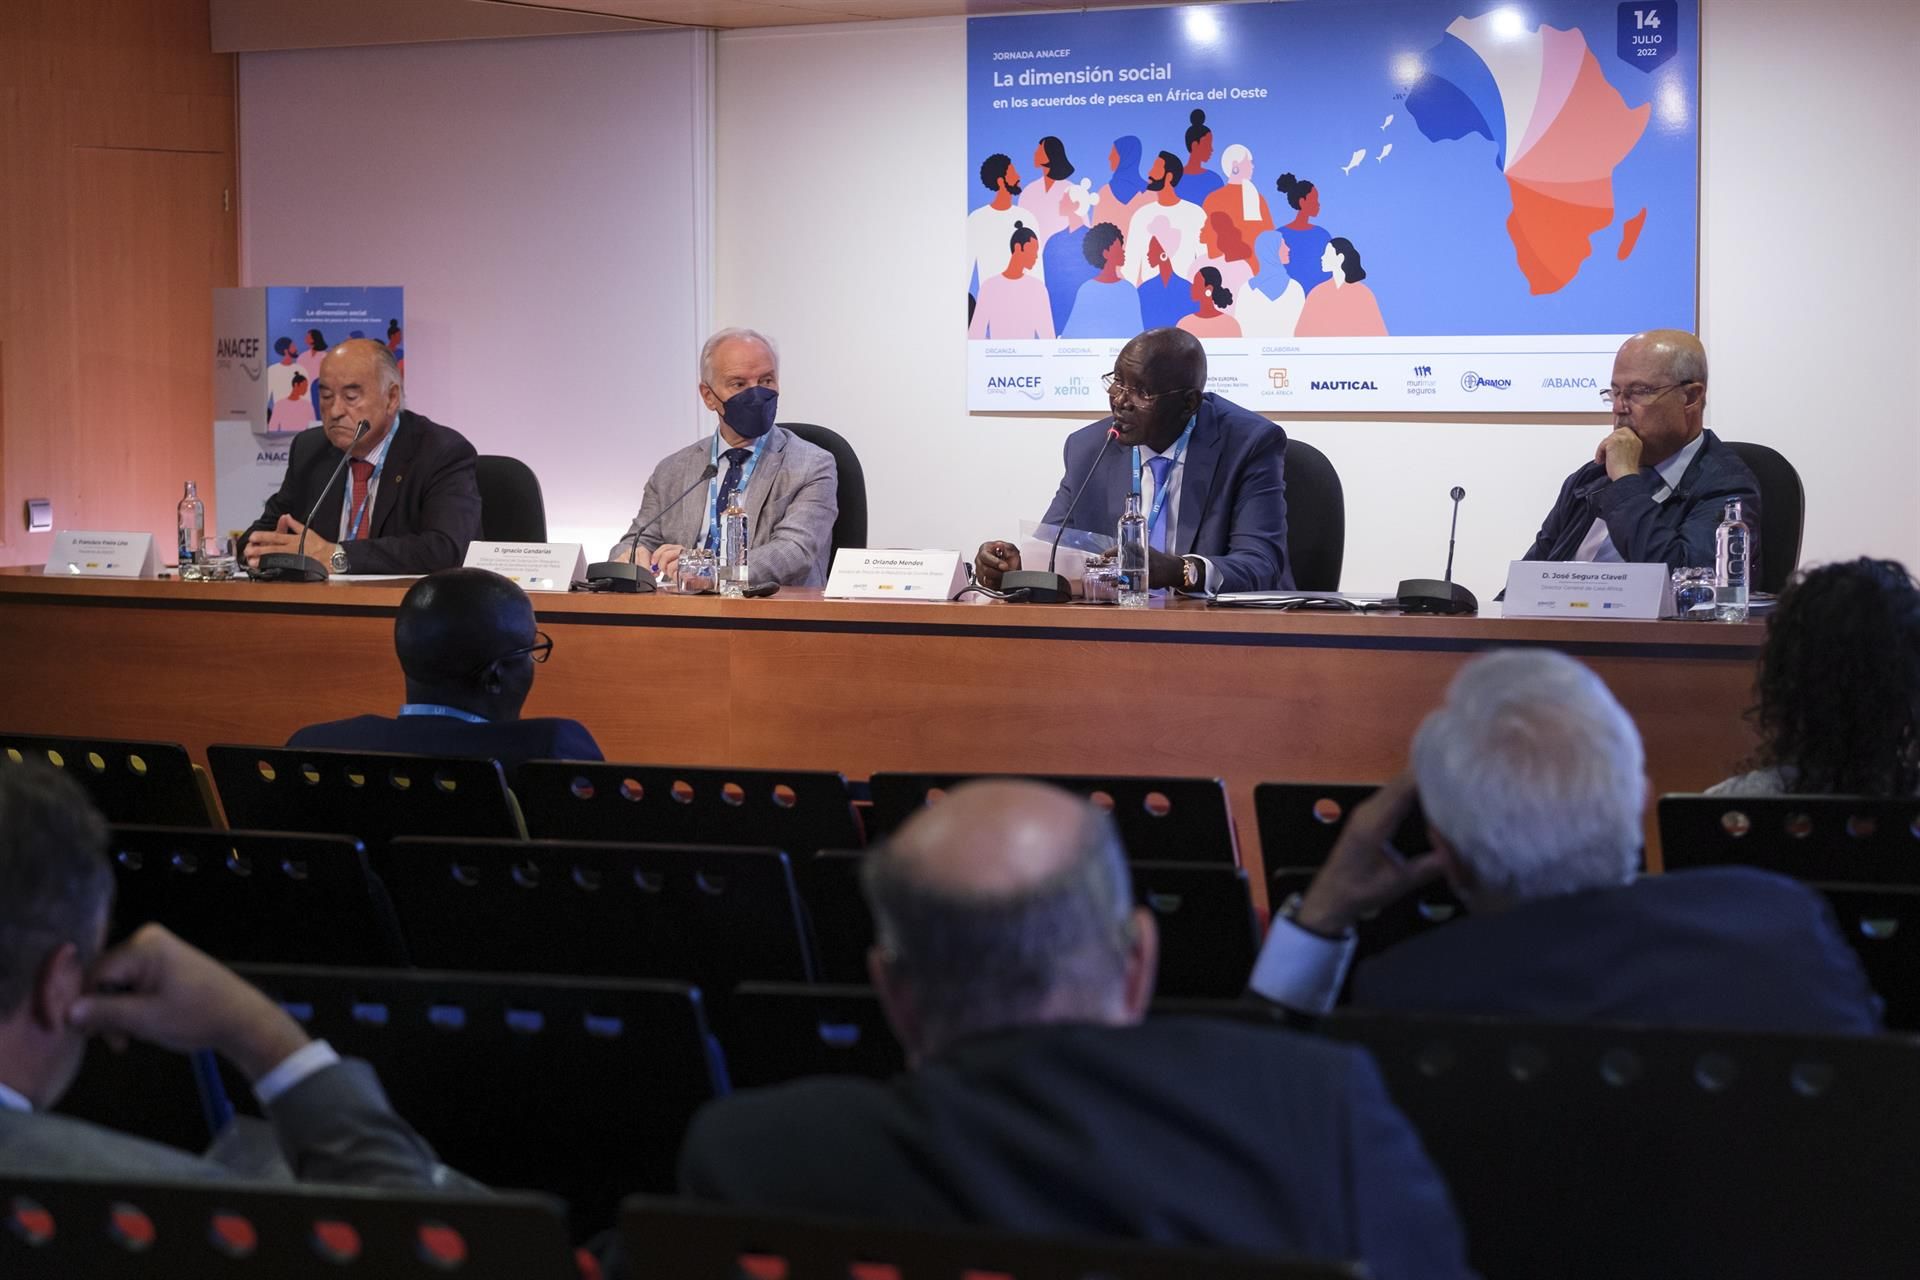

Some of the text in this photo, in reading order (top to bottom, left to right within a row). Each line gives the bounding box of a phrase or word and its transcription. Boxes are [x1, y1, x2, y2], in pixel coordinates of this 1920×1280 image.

[1633, 9, 1661, 30] 14
[1631, 34, 1663, 45] JULIO
[992, 49, 1071, 61] JORNADA ANACEF
[1636, 48, 1658, 57] 2022
[993, 62, 1172, 87] La dimensión social
[992, 87, 1268, 109] en los acuerdos de pesca en África del Oeste
[216, 337, 260, 359] ANACEF
[987, 376, 1042, 388] ANACEF
[1310, 381, 1378, 390] NAUTICAL
[1054, 385, 1090, 396] xenia
[1407, 387, 1437, 396] seguros
[257, 452, 289, 461] ANAC
[1552, 572, 1570, 580] José
[1571, 573, 1599, 581] Segura
